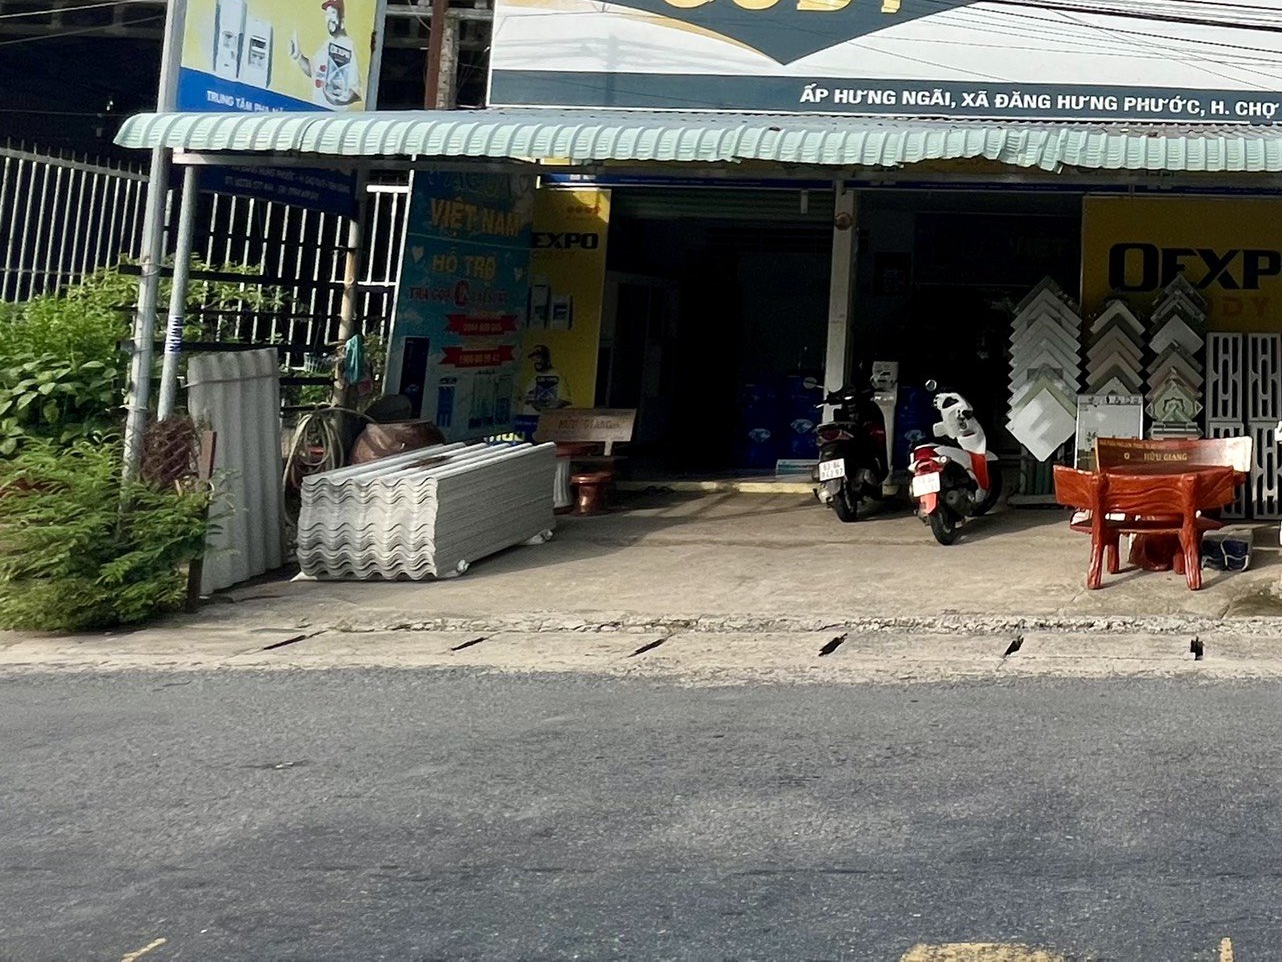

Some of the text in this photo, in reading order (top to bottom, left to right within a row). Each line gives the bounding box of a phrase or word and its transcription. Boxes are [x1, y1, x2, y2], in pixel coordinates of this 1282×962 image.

[206, 90, 235, 107] TRUNG
[800, 83, 829, 103] ẤP
[834, 88, 896, 105] HƯNG
[902, 89, 957, 109] NGÃI,
[961, 90, 989, 108] XÃ
[994, 91, 1051, 110] ĐĂNG
[1057, 94, 1118, 111] HƯNG
[1123, 95, 1206, 117] PHƯỚC,
[1210, 101, 1230, 115] H.
[1235, 101, 1280, 119] CHỢ
[1163, 452, 1188, 462] GIANG
